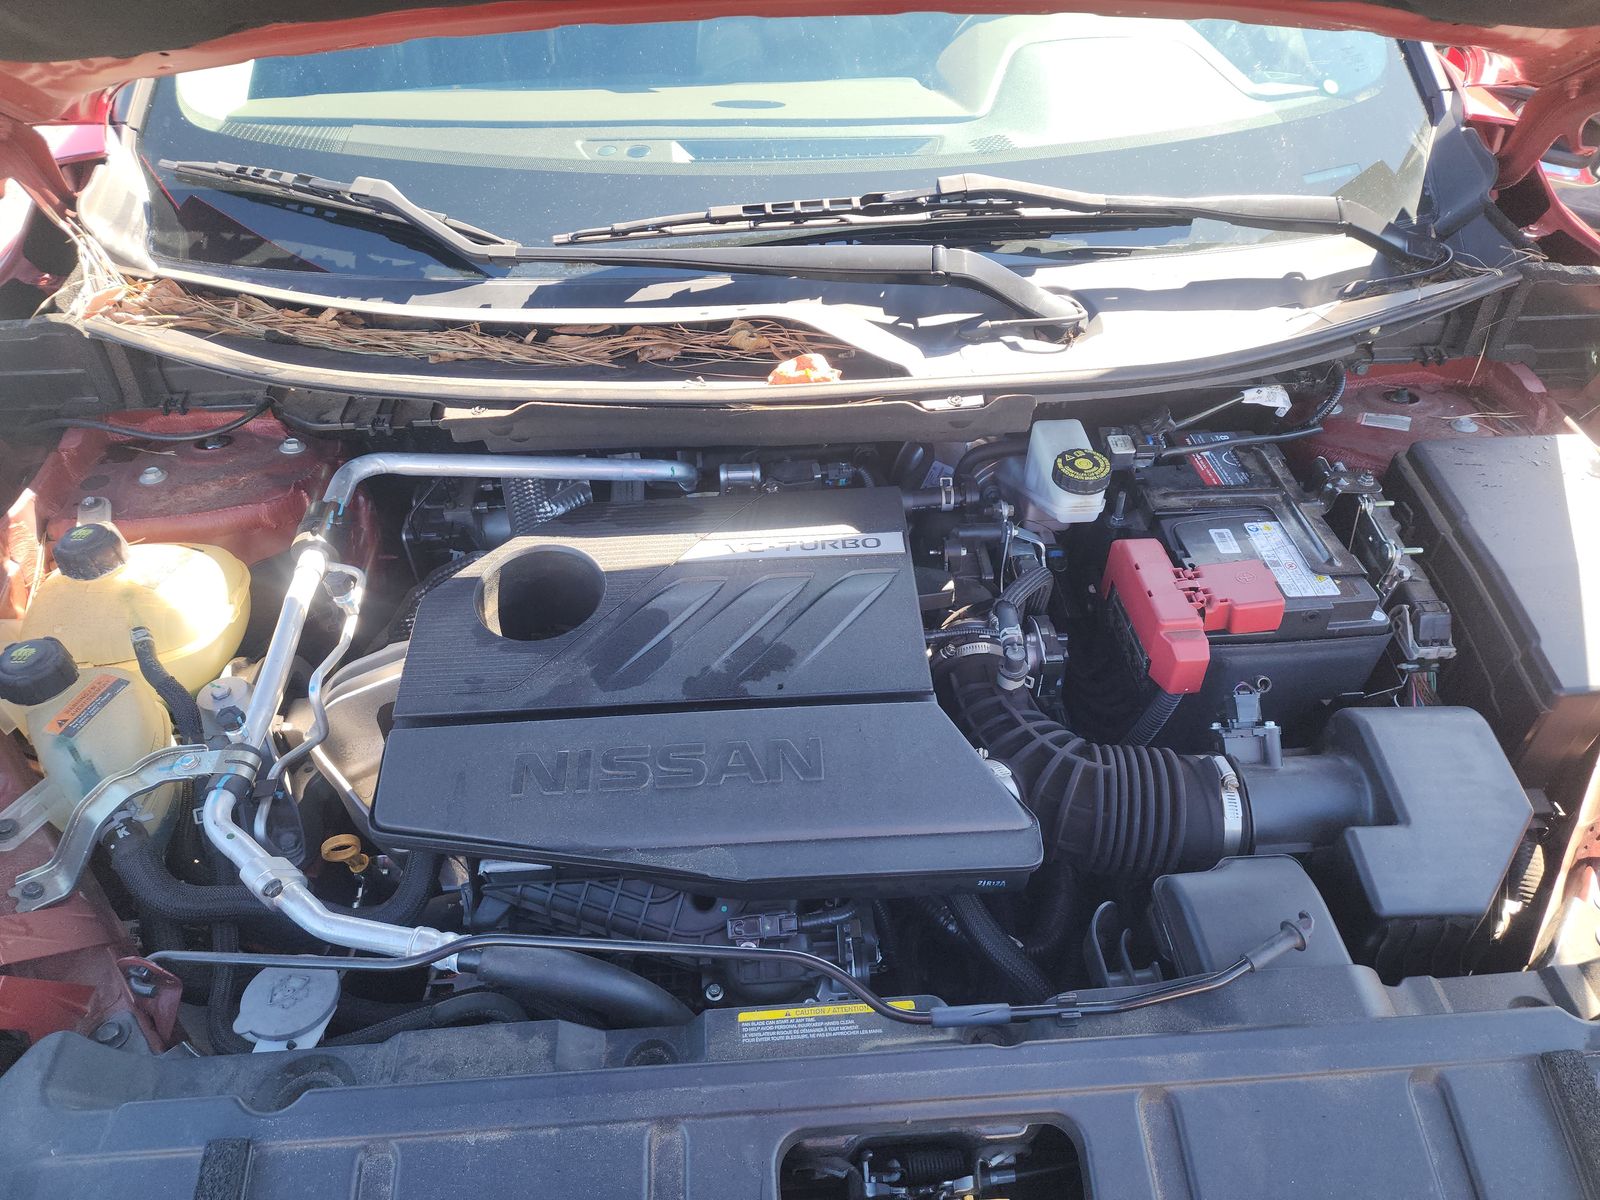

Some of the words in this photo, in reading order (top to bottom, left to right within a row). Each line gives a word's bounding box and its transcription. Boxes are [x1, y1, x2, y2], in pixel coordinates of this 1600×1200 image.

[511, 737, 824, 797] NISSAN
[795, 1008, 825, 1016] CAUTION
[832, 1005, 869, 1013] ATTENTION
